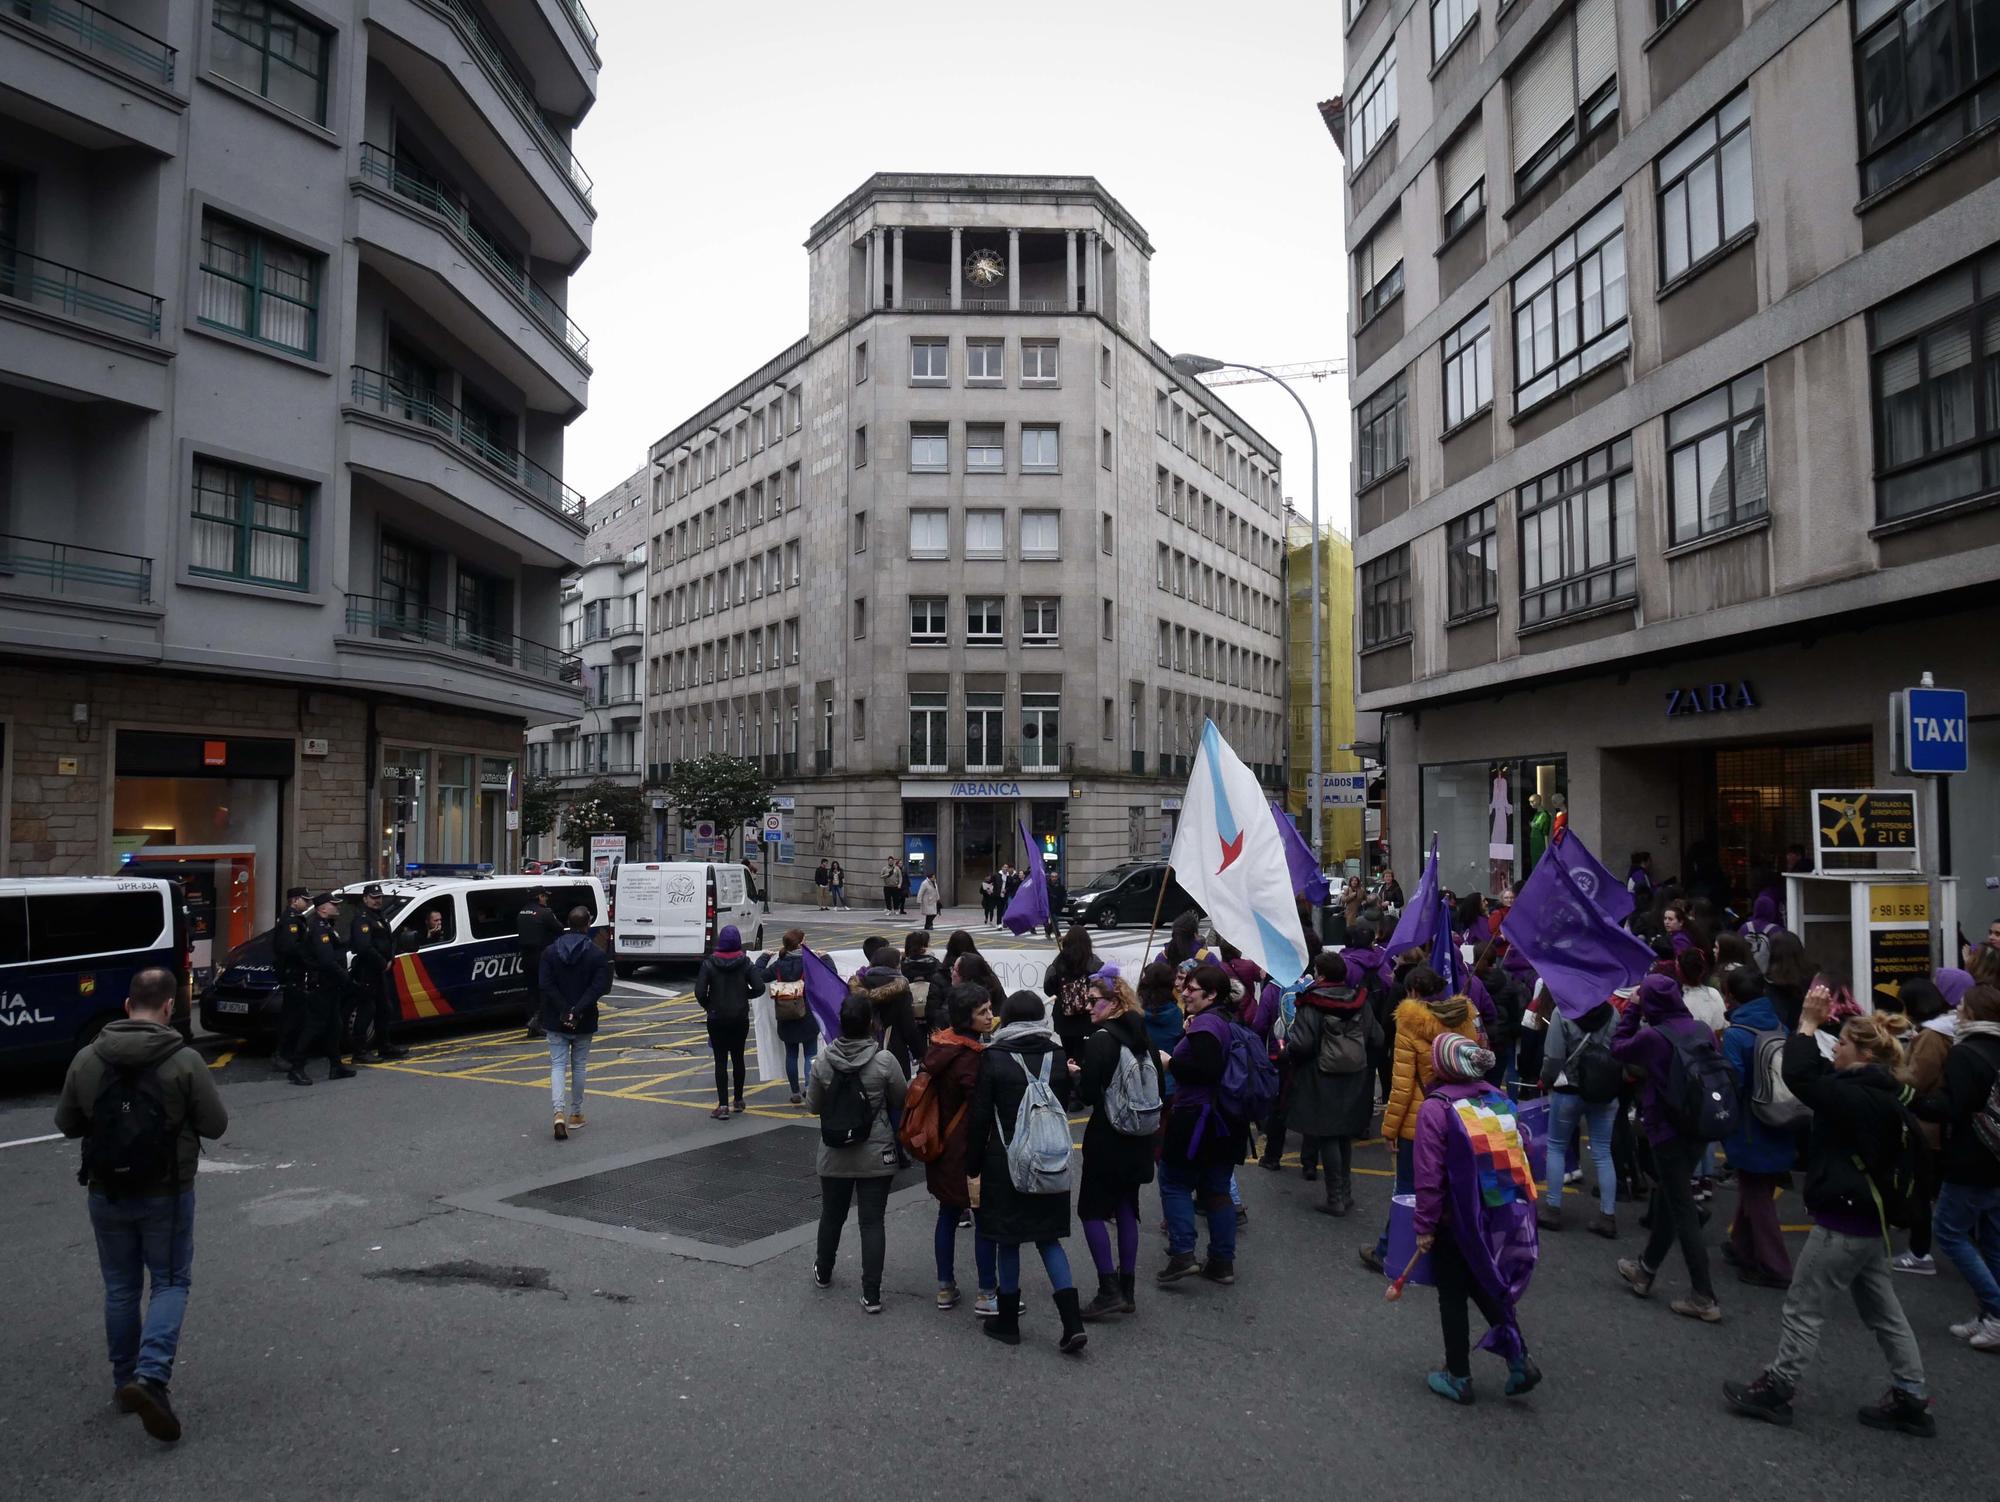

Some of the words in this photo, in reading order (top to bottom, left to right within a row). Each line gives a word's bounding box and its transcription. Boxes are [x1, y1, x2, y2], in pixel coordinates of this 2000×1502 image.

[1665, 680, 1760, 716] ZARA
[1913, 717, 1963, 743] TAXI
[1308, 777, 1351, 787] CZADOS
[1877, 822, 1913, 830] PERSONAS
[1878, 831, 1893, 843] 21
[117, 882, 159, 890] UPR-83A
[1880, 905, 1895, 916] 981
[1899, 905, 1911, 916] 56
[1913, 904, 1925, 915] 92
